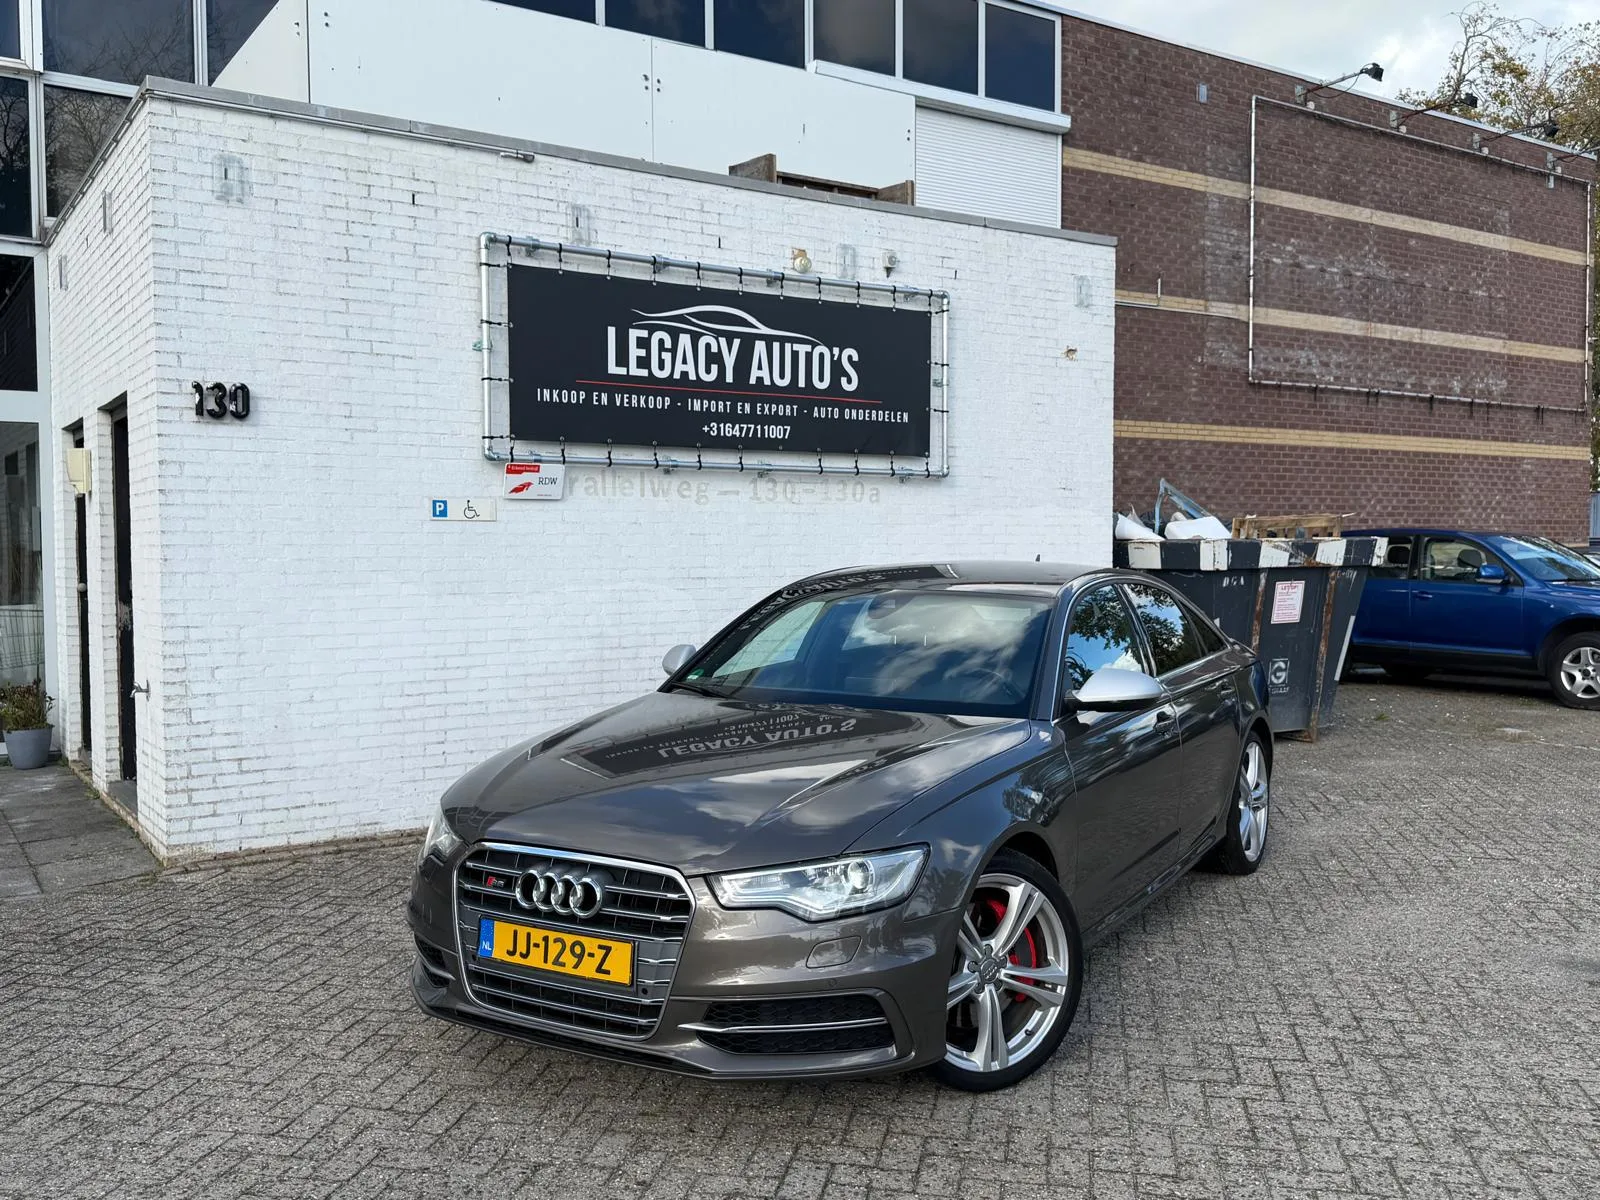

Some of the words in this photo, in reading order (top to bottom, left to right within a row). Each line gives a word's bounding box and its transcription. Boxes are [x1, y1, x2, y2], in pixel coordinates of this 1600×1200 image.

[607, 326, 741, 383] LEGACY
[749, 340, 859, 392] AUTO'S
[192, 380, 250, 419] 130
[537, 388, 586, 404] INKOOP
[593, 392, 608, 406] EN
[615, 393, 671, 409] VERKOOP
[688, 398, 731, 413] IMPORT
[737, 402, 751, 415] EN
[757, 403, 798, 417] EXPORT
[813, 406, 839, 419] AUTO
[844, 408, 909, 423] ONDERDELEN
[702, 422, 791, 439] +31647711007
[538, 476, 558, 486] RDW
[435, 502, 444, 515] P
[482, 940, 492, 951] NL
[506, 929, 613, 976] JJ-129-Z
